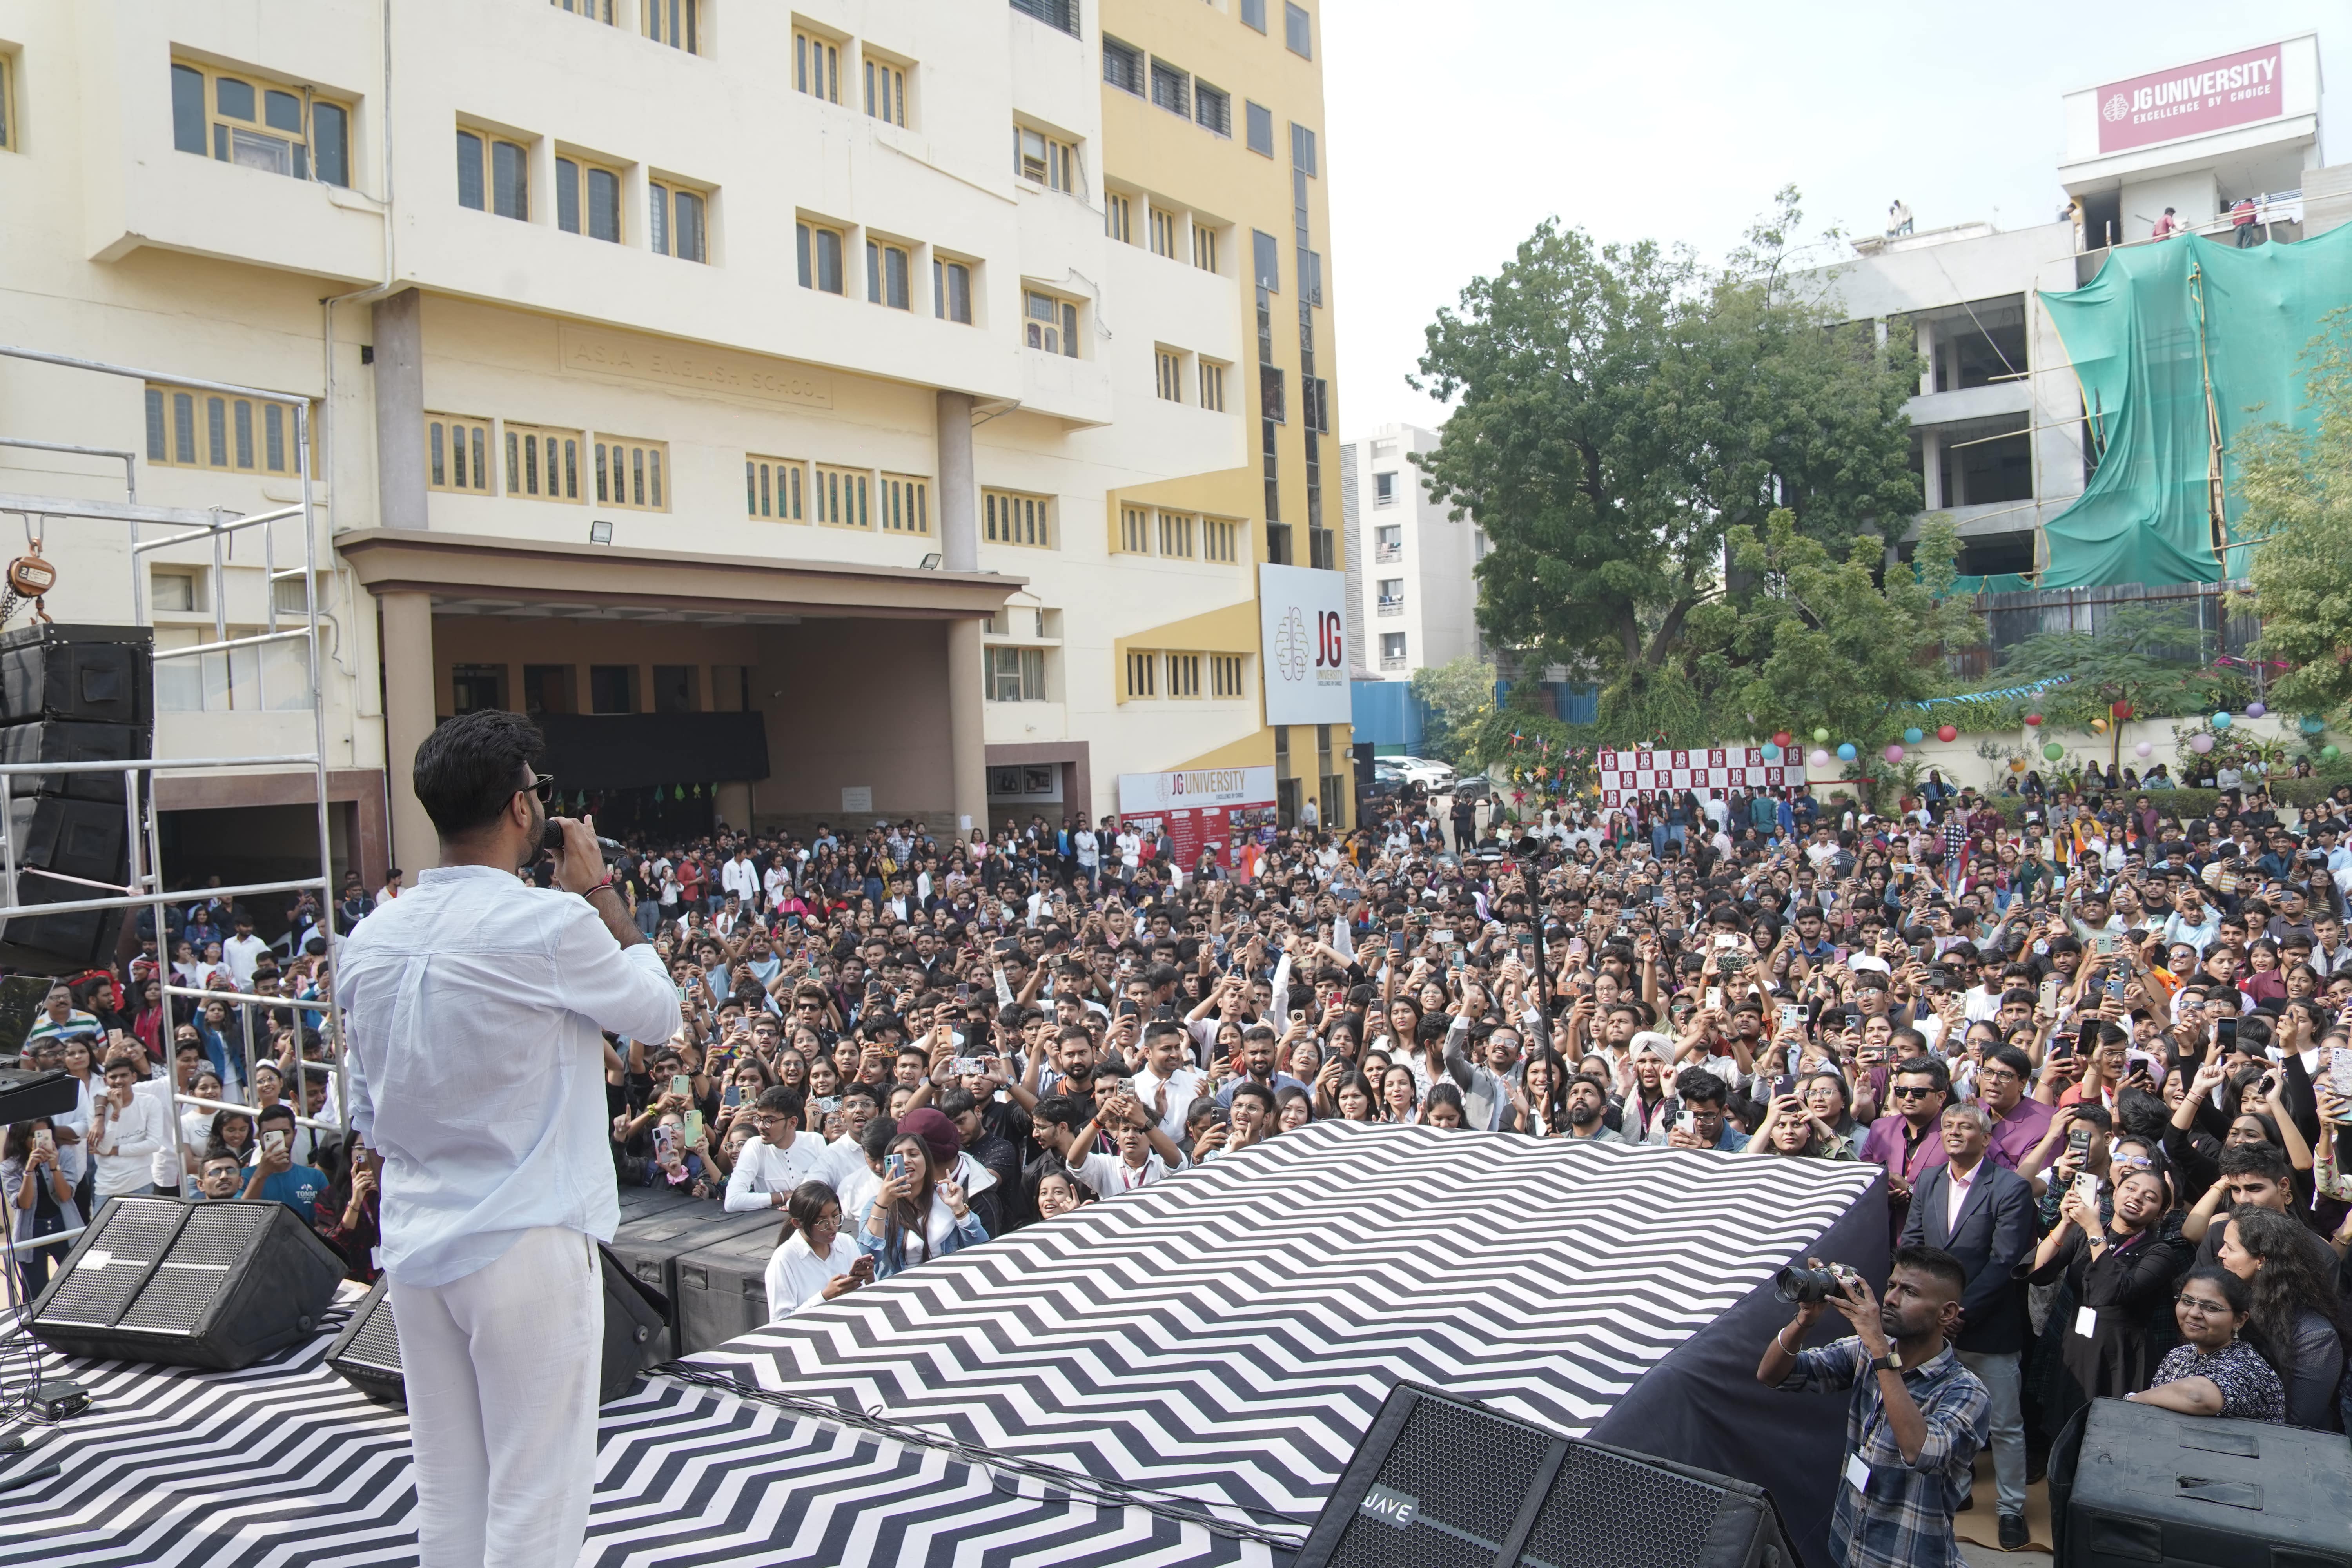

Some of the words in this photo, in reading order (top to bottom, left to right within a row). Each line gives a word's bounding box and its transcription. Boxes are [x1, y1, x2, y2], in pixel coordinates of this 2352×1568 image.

[2131, 87, 2152, 112] JG
[2155, 56, 2277, 106] UNIVERSITY
[2134, 101, 2200, 124] EXCELLENCE
[2208, 95, 2221, 107] BY
[2230, 84, 2271, 102] CHOICE
[1316, 610, 1342, 668] JG
[1604, 754, 1615, 767] JG
[1639, 753, 1650, 766] JG
[1675, 751, 1685, 764] JG
[1712, 750, 1722, 763] JG
[1749, 749, 1760, 762] JG
[1788, 748, 1799, 762] JG
[1623, 772, 1633, 784] JG
[1659, 771, 1669, 784] JG
[1695, 770, 1705, 783] JG
[1731, 769, 1742, 782] JG
[1769, 768, 1780, 781] JG
[1172, 773, 1183, 795] JG
[1185, 770, 1245, 794] UNIVERSITY
[1607, 791, 1617, 803] JG
